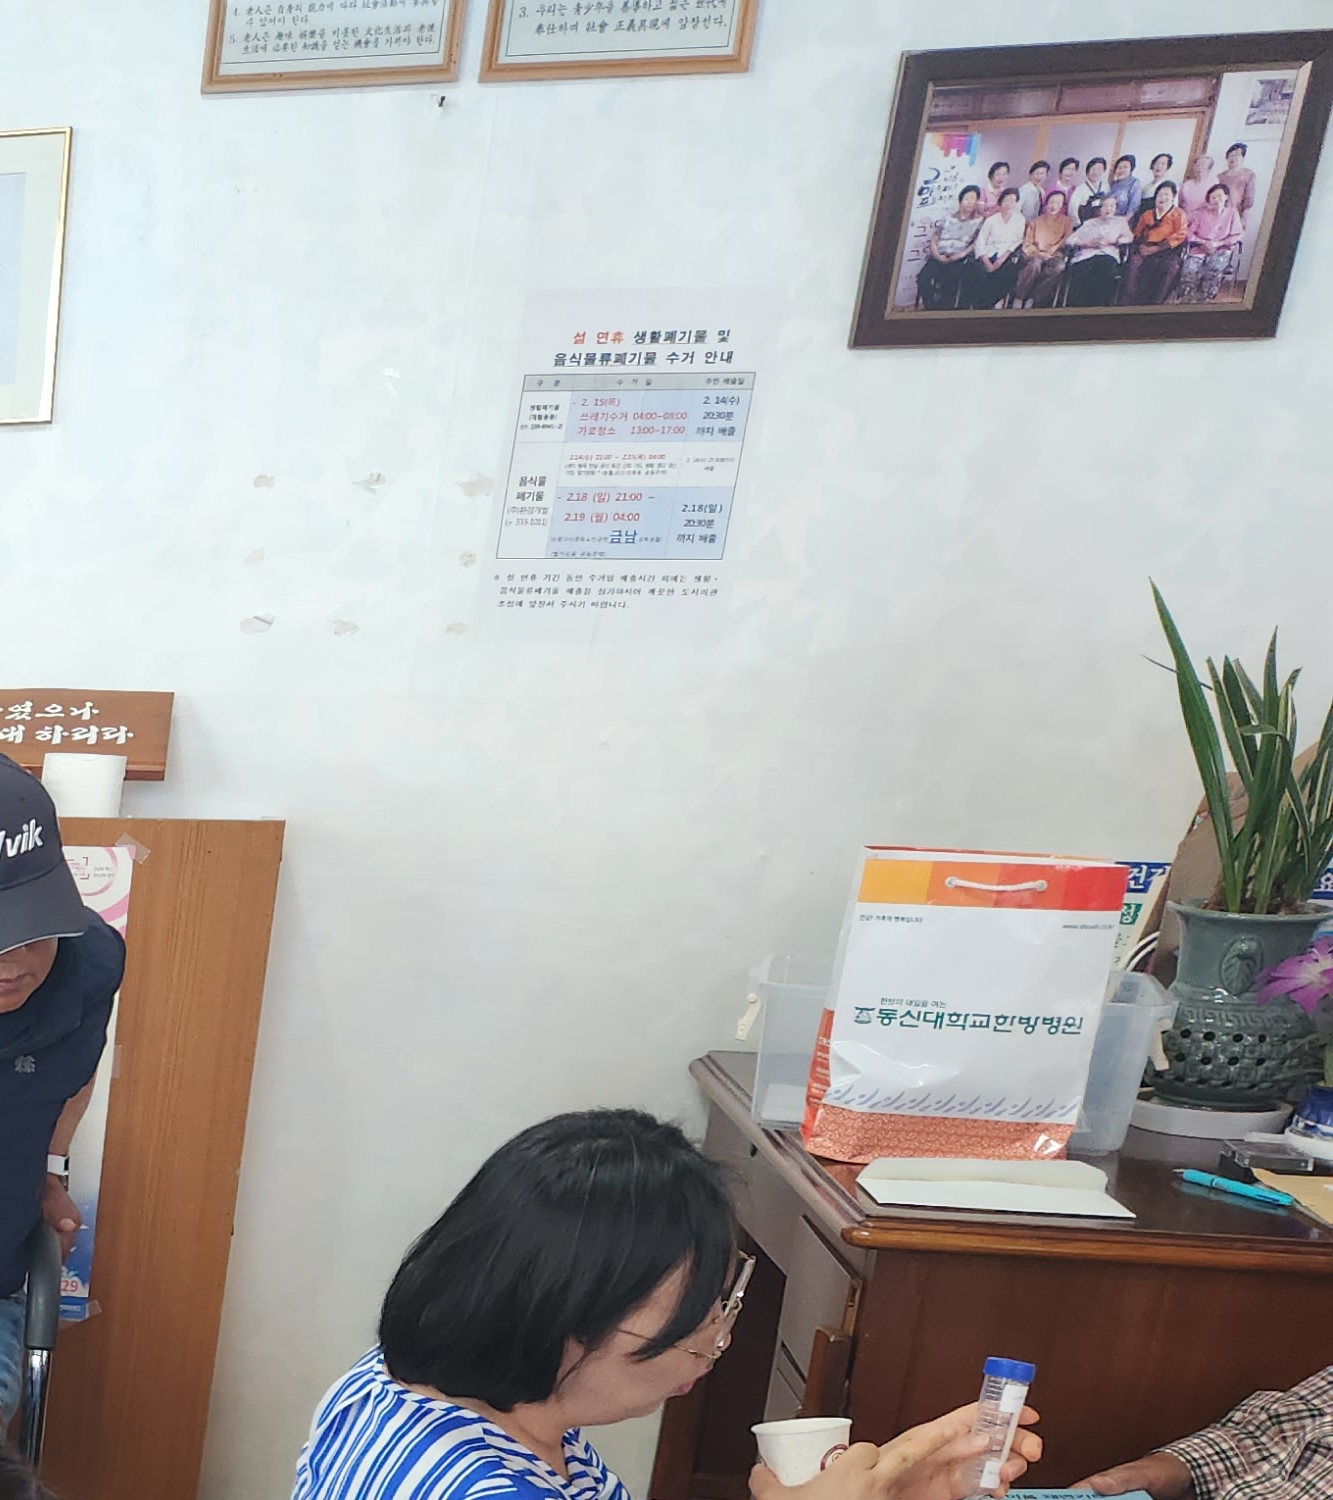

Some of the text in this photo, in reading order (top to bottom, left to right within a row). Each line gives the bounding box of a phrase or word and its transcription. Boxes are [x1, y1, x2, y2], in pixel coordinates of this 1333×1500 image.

[573, 329, 731, 344] 설 연휴 생활폐기물 및
[553, 350, 734, 366] 음식물류폐기물 수거 안내
[519, 476, 547, 487] 음식물
[609, 529, 638, 544] 금남
[34, 723, 135, 745] 하리라
[876, 1008, 1083, 1035] 동신대학교한방병원
